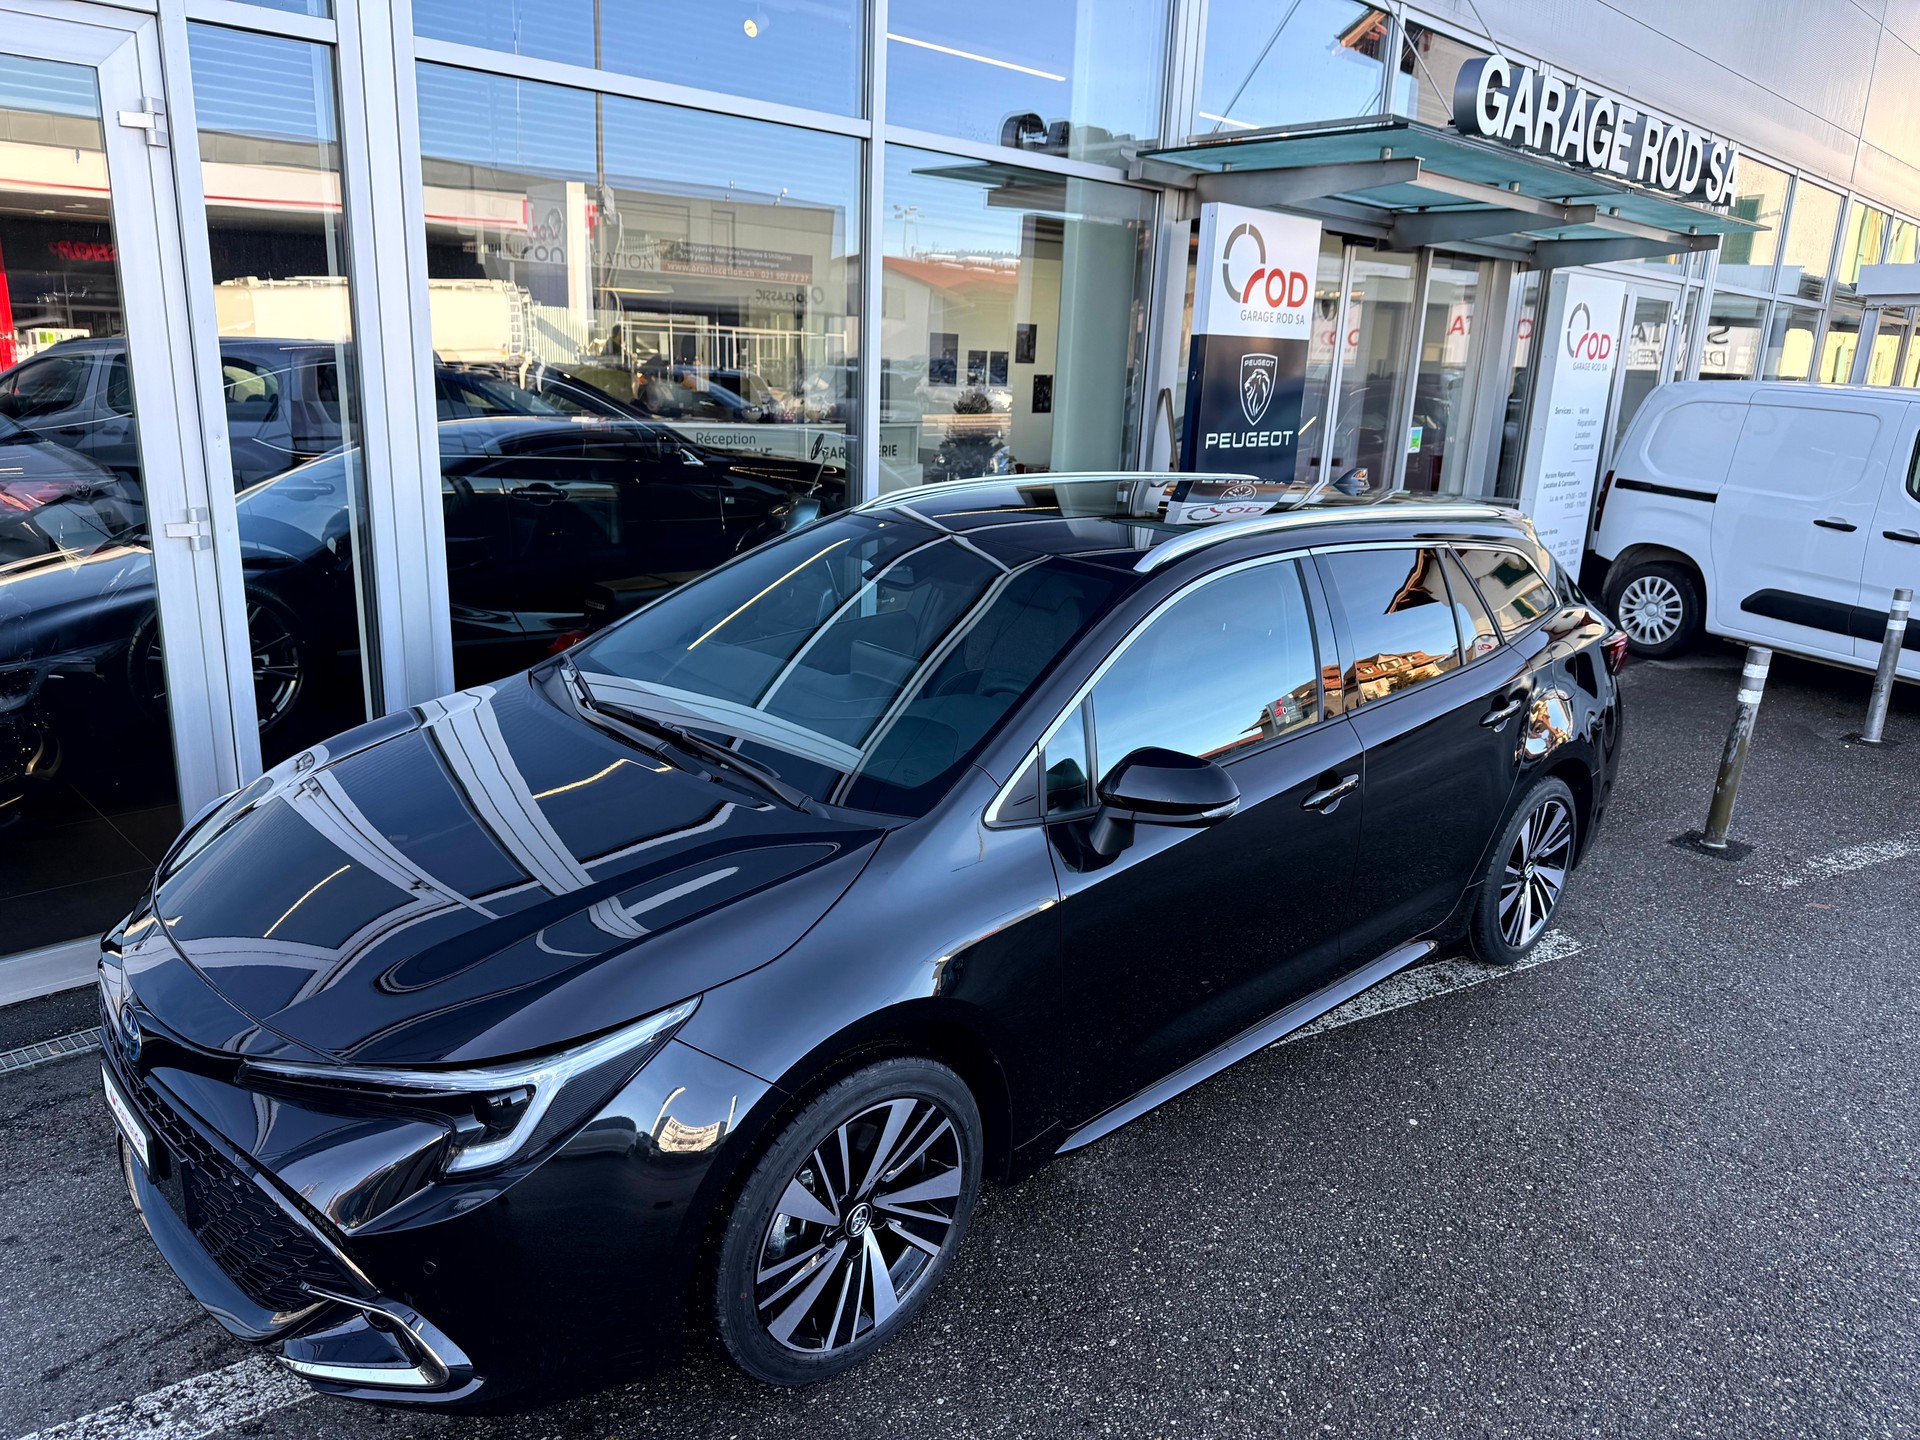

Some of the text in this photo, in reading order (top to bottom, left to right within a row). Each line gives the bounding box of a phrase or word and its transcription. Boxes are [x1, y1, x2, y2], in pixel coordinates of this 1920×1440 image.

[1476, 54, 1739, 207] GARAGE ROD SA
[1240, 309, 1305, 325] GARAGE ROD SA
[1244, 359, 1275, 367] PEUGEOT
[1573, 361, 1591, 371] GARAGE
[696, 432, 756, 446] Réception
[1205, 431, 1294, 449] PEUGEOT
